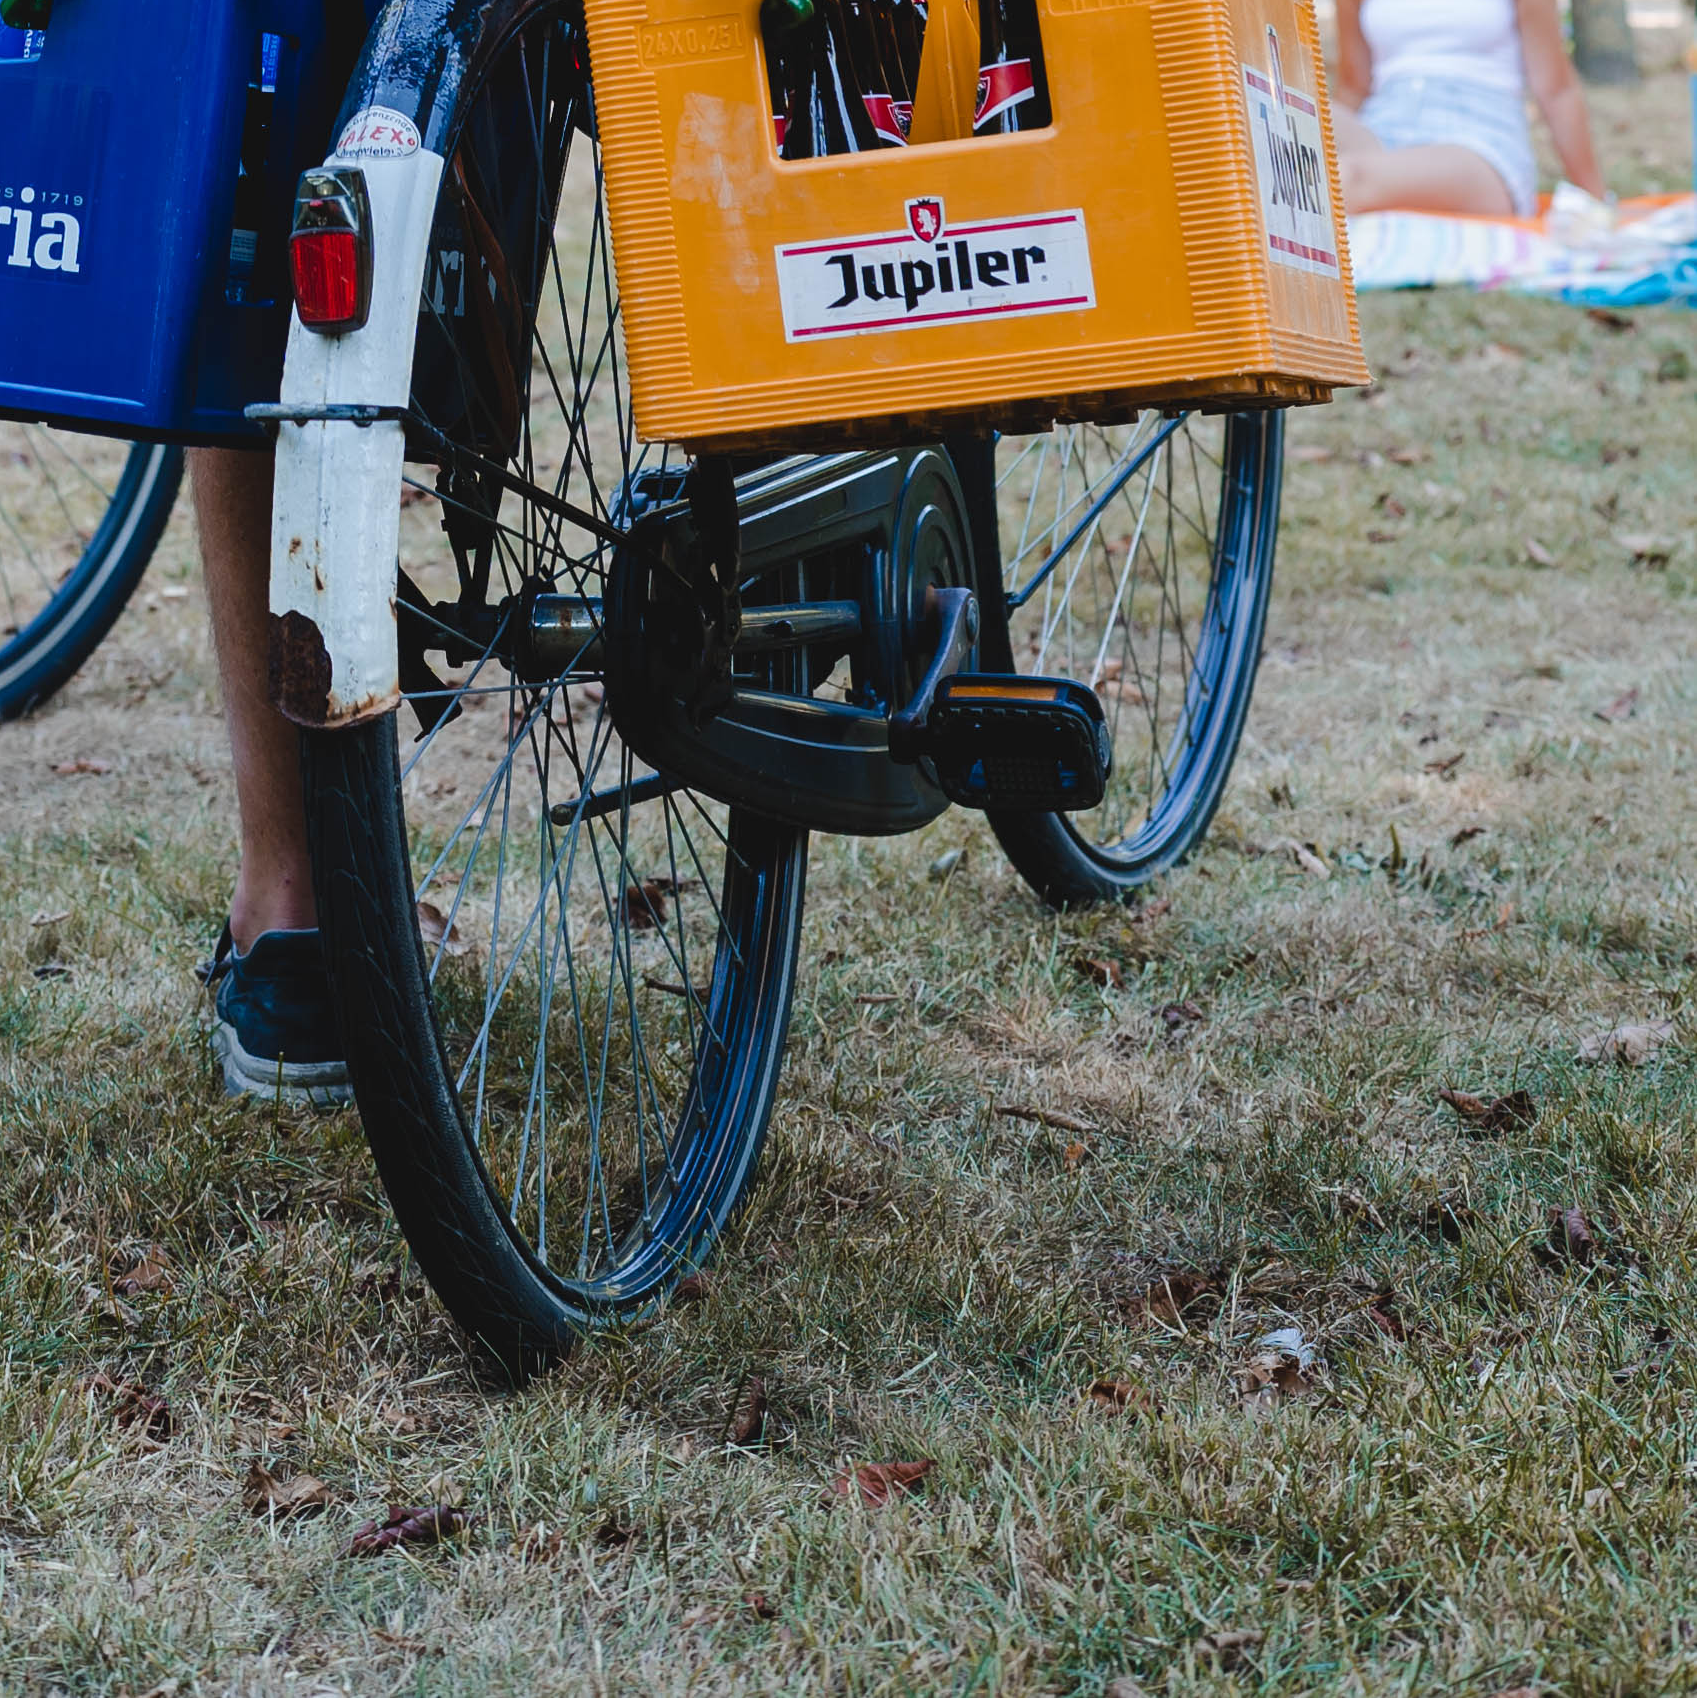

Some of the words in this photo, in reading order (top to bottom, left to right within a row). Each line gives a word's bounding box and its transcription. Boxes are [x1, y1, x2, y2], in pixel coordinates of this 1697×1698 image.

[343, 125, 404, 147] ALEX
[41, 191, 84, 206] 1719
[824, 240, 1047, 313] Jupiler
